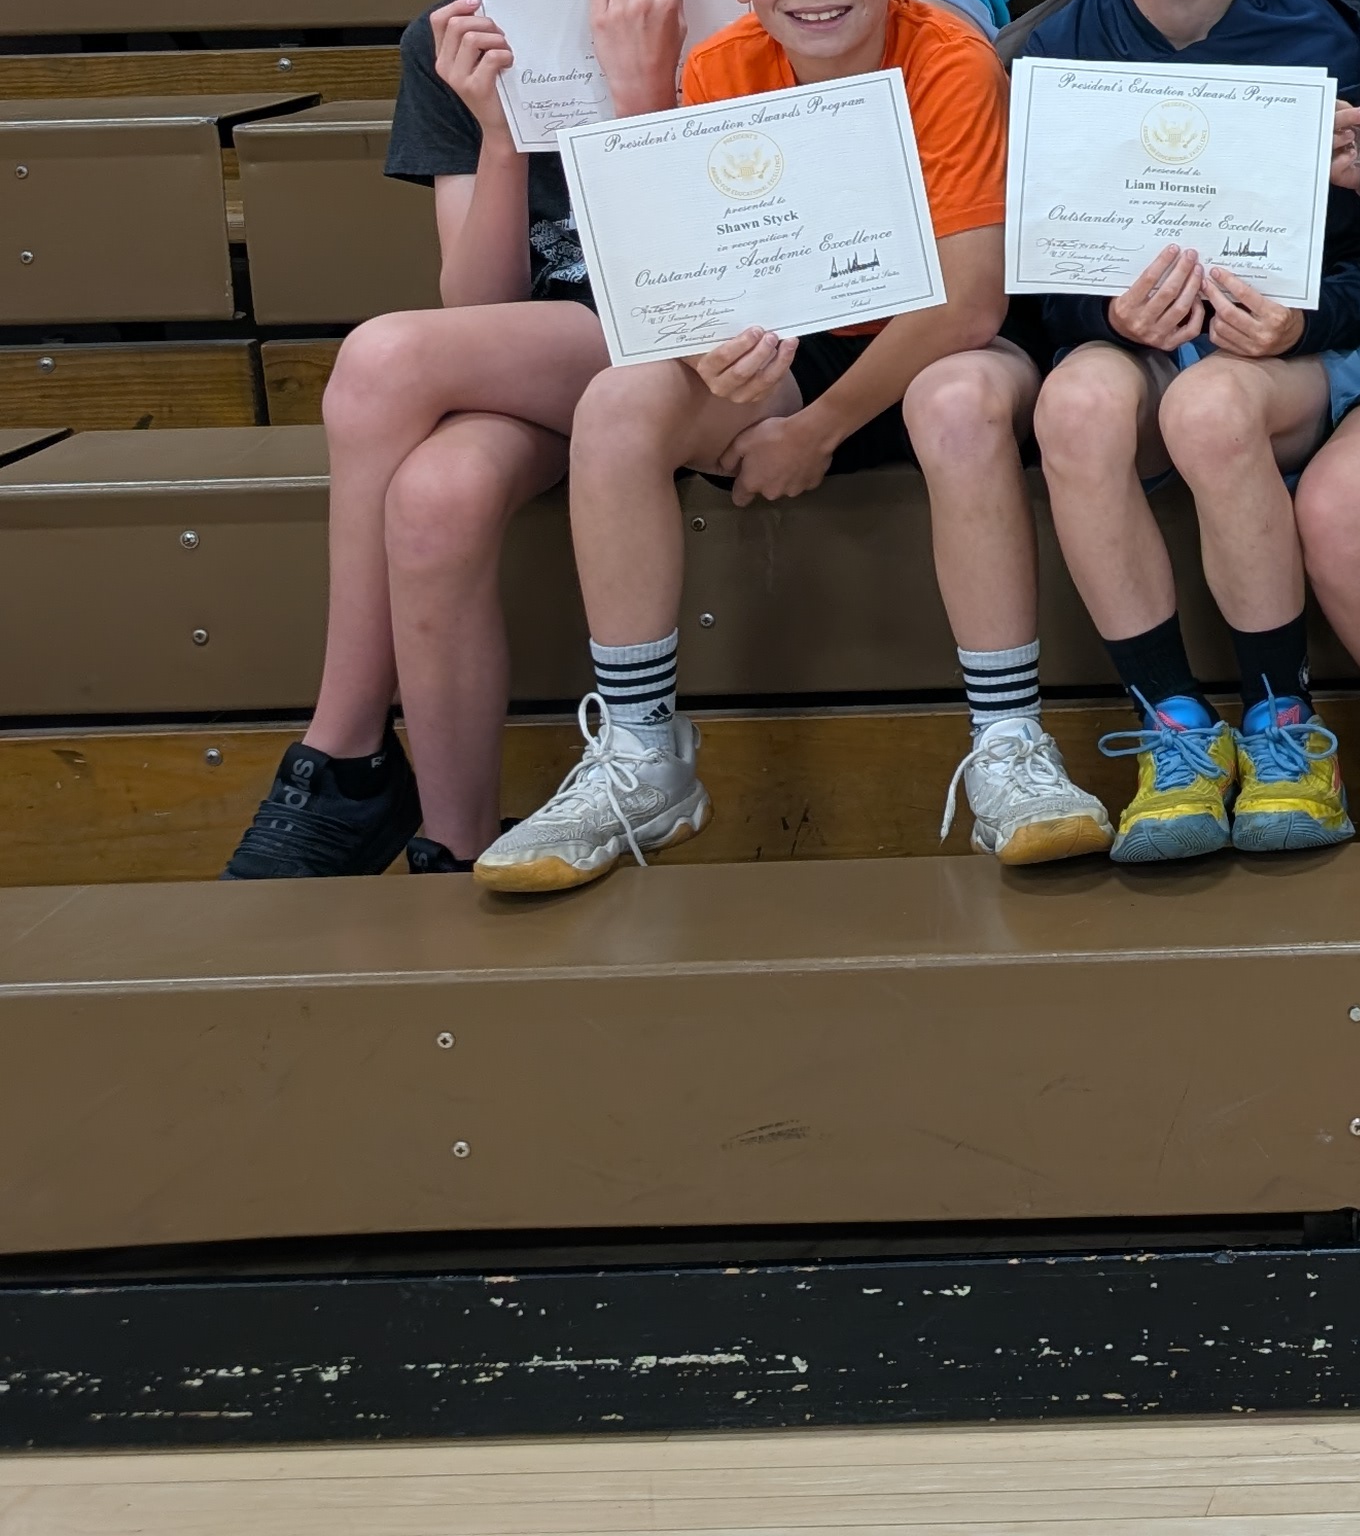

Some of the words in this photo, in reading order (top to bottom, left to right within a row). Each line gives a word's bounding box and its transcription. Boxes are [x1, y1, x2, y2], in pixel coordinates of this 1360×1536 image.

[1058, 71, 1123, 92] President's
[1127, 77, 1184, 96] Education
[1187, 81, 1236, 100] Awards
[1241, 84, 1296, 108] Program
[603, 124, 676, 152] President's
[682, 119, 744, 138] Education
[747, 102, 800, 126] Awards
[805, 94, 866, 117] Program
[1125, 178, 1155, 190] Liam
[1159, 180, 1216, 194] Hornstein
[723, 198, 773, 219] presented
[776, 196, 786, 204] to
[1048, 204, 1132, 229] Outstanding
[1141, 209, 1211, 227] Academic
[1218, 214, 1286, 233] Excellence
[716, 220, 759, 234] Shawn
[762, 210, 798, 226] Styck
[1153, 227, 1183, 237] 2026
[716, 244, 728, 252] in
[732, 233, 788, 250] recognition
[790, 224, 804, 239] of
[635, 262, 726, 287] Outstanding
[736, 245, 811, 268] Academic
[818, 229, 892, 251] Excellence
[753, 263, 782, 278] 2026
